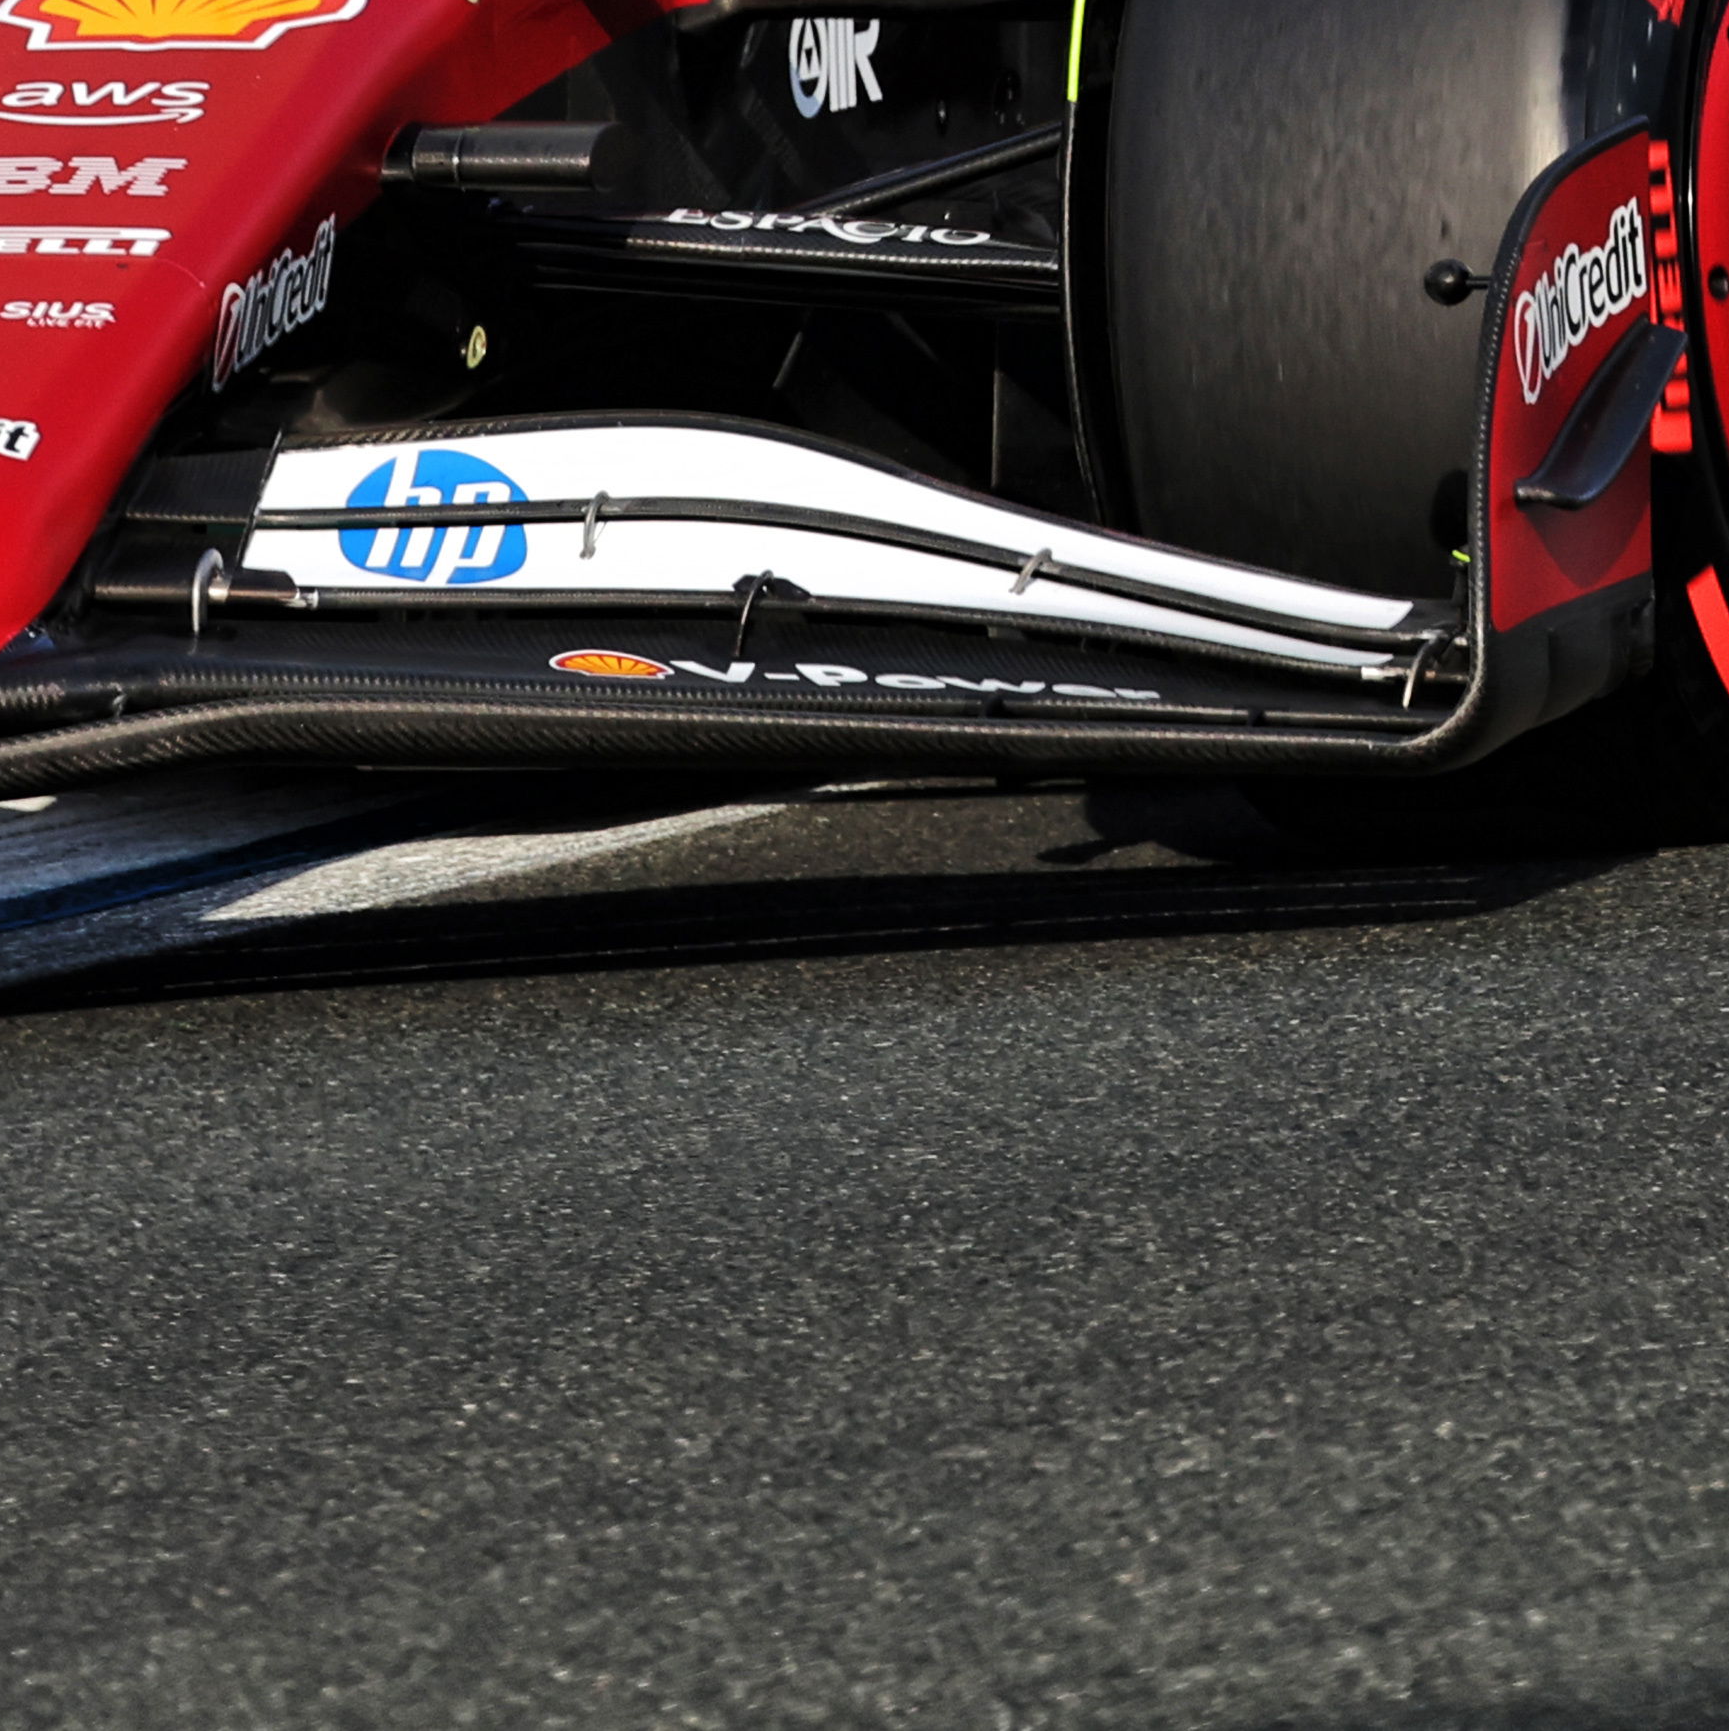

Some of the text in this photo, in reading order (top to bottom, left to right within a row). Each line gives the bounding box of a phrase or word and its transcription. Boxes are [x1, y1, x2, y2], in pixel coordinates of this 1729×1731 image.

[0, 80, 212, 108] aws
[667, 206, 991, 246] ESPACIO
[1536, 203, 1644, 373] UniCredit
[364, 450, 513, 585] hp
